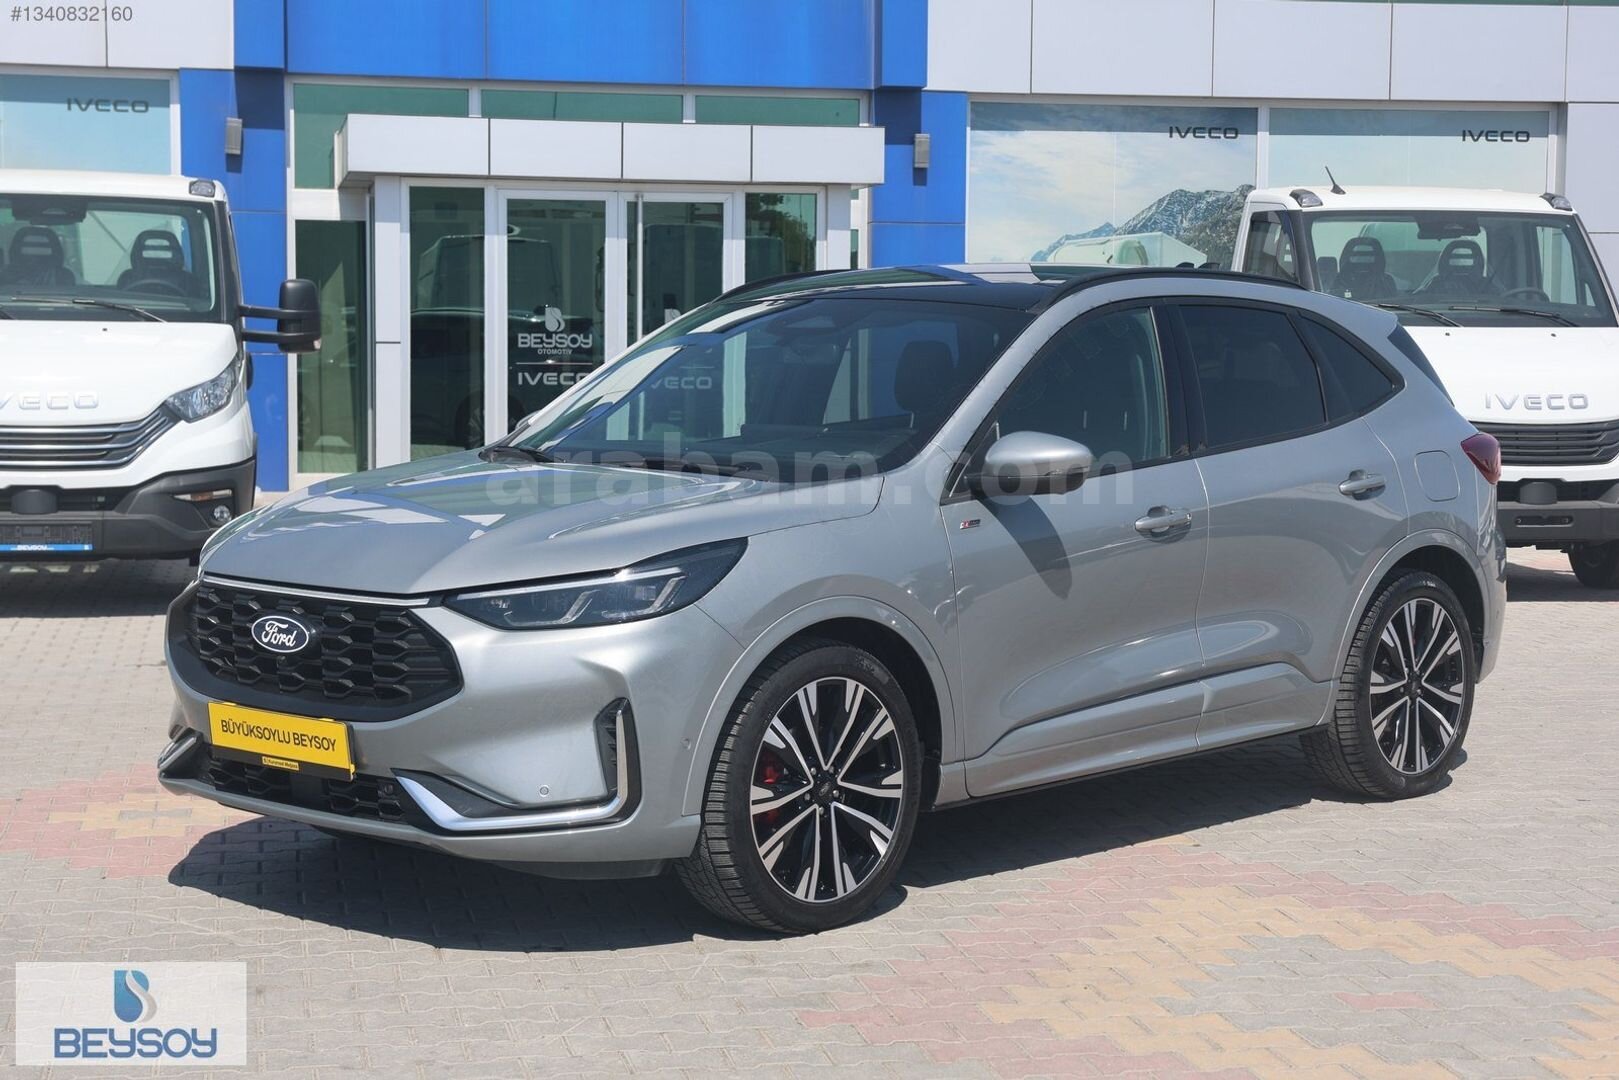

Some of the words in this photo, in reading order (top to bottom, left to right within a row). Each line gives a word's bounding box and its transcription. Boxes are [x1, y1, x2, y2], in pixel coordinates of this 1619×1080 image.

[66, 97, 149, 113] IVECO
[1168, 126, 1239, 140] IVECO
[1461, 129, 1531, 143] IVECO
[517, 333, 593, 348] BEYSOY
[650, 375, 713, 390] VECO
[0, 391, 99, 410] VECO
[1484, 392, 1590, 410] IVECO
[220, 718, 291, 745] BÜYÜKSOYLU
[292, 732, 337, 752] BEYSOY
